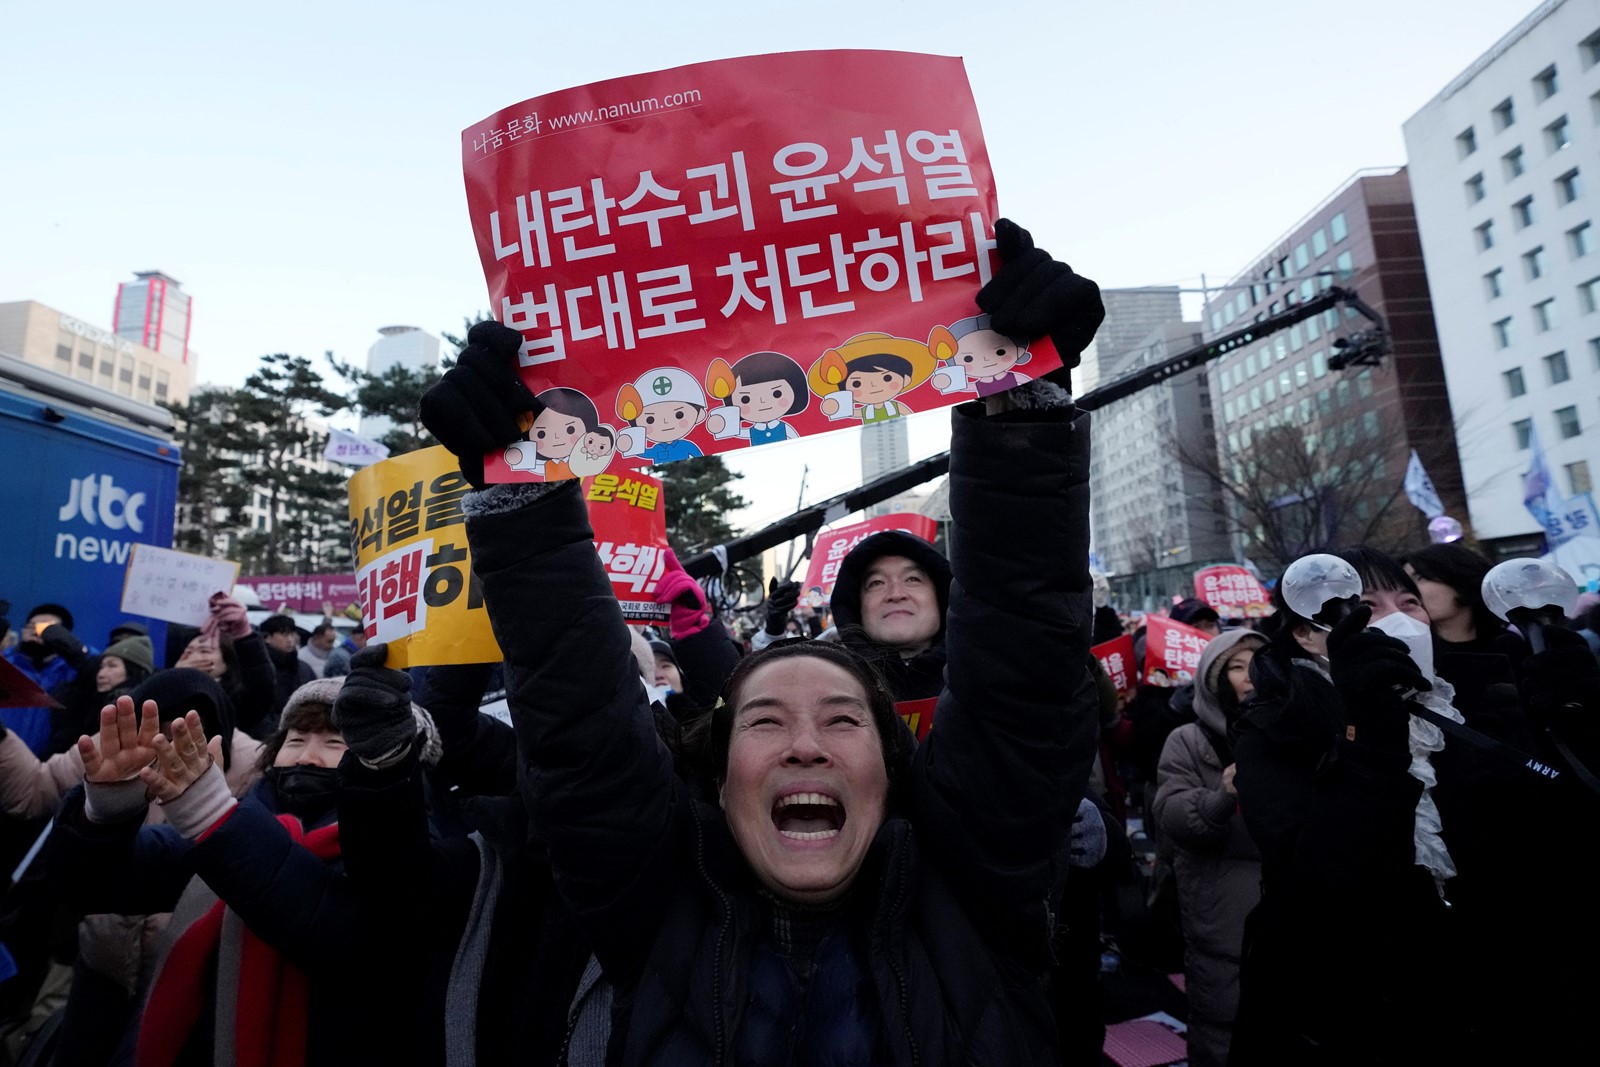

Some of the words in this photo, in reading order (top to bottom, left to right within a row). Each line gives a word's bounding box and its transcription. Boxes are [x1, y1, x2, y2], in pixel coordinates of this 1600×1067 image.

[473, 112, 543, 154] 나눔문화
[548, 89, 702, 130] www.nanum.com
[490, 151, 757, 269] 내란수괴
[769, 128, 979, 223] 윤석열
[502, 263, 706, 368] 법대로
[715, 212, 998, 325] 처단하라
[586, 474, 659, 511] 윤석열
[55, 532, 135, 565] new
[1204, 574, 1259, 592] 윤석열을
[1205, 588, 1265, 606] 탄핵하라
[1525, 759, 1560, 779] ARMY
